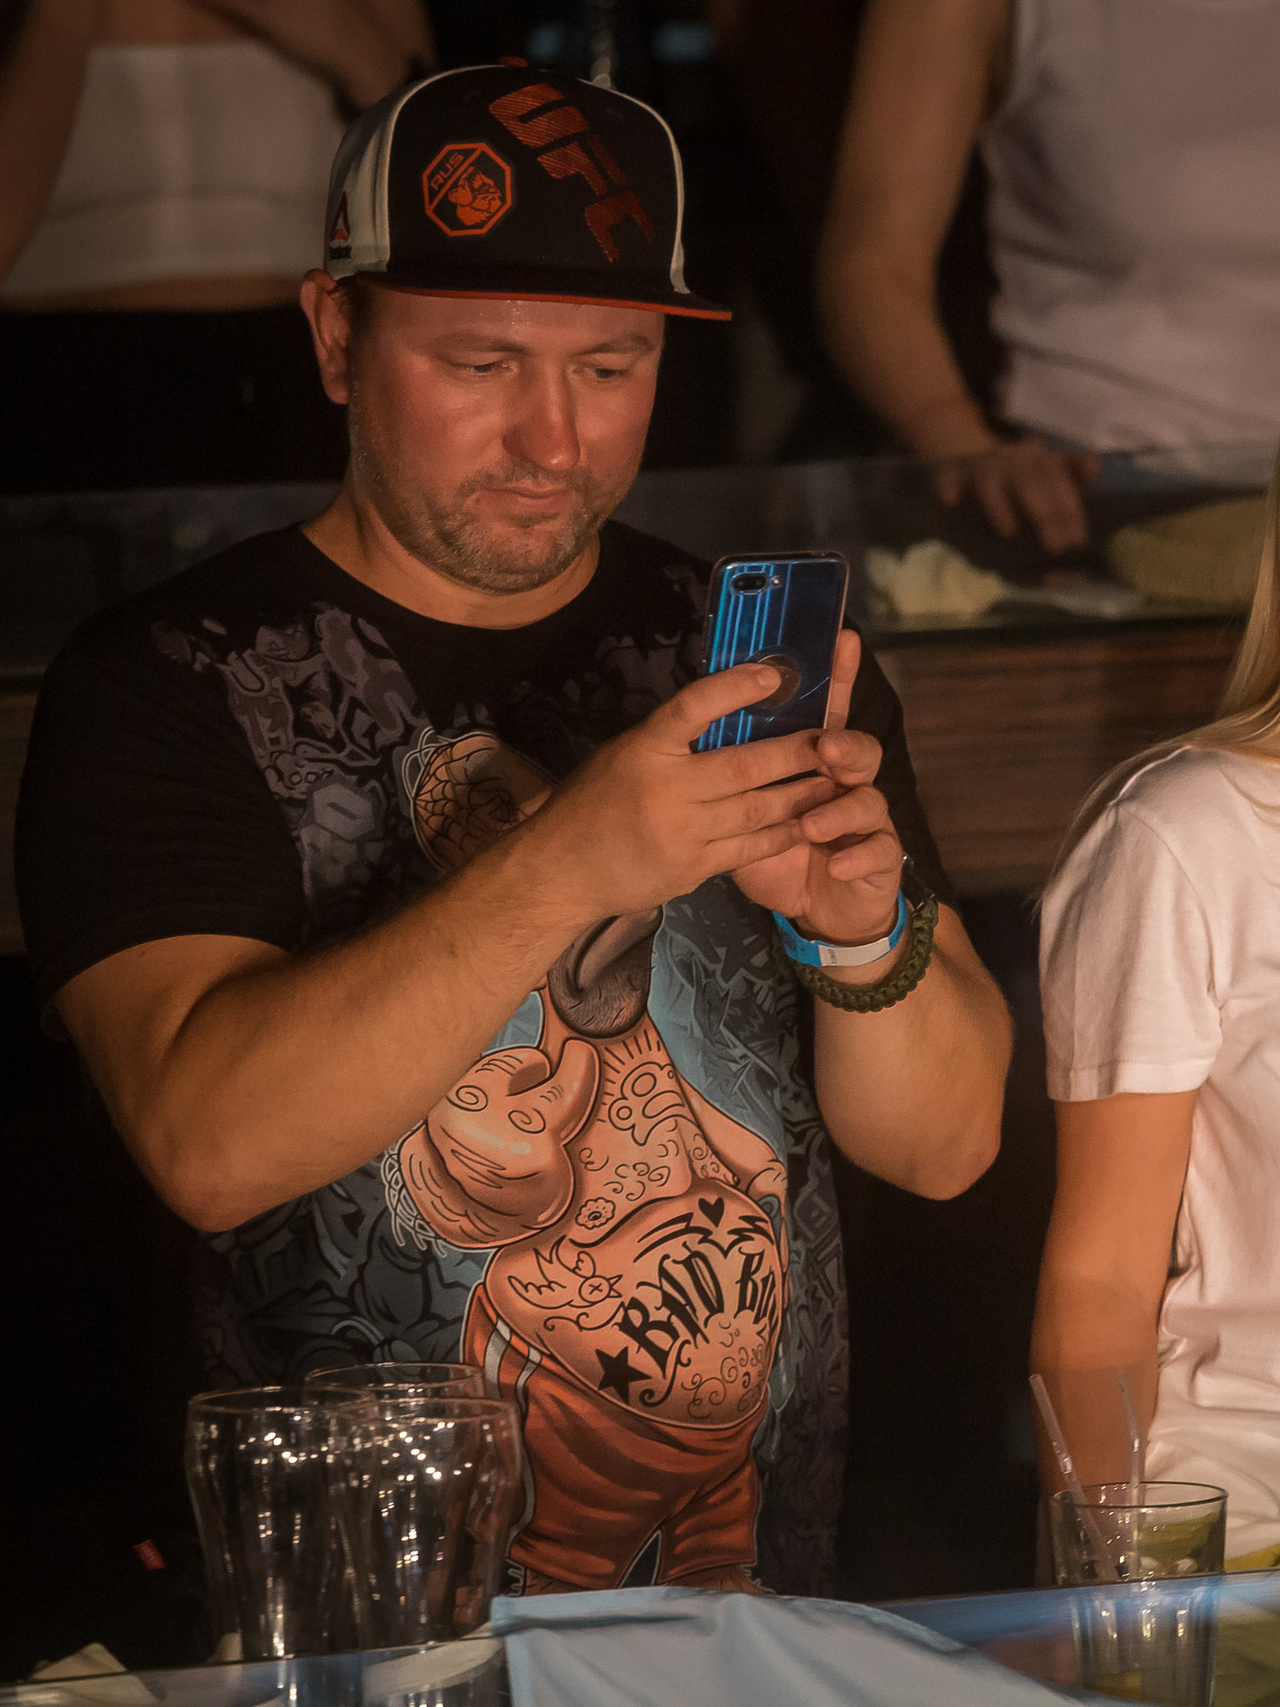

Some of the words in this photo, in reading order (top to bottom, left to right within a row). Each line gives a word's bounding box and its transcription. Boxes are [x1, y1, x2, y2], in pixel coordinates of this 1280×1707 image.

[430, 152, 464, 190] RUS
[488, 83, 656, 264] UFC
[612, 1241, 724, 1380] BAD
